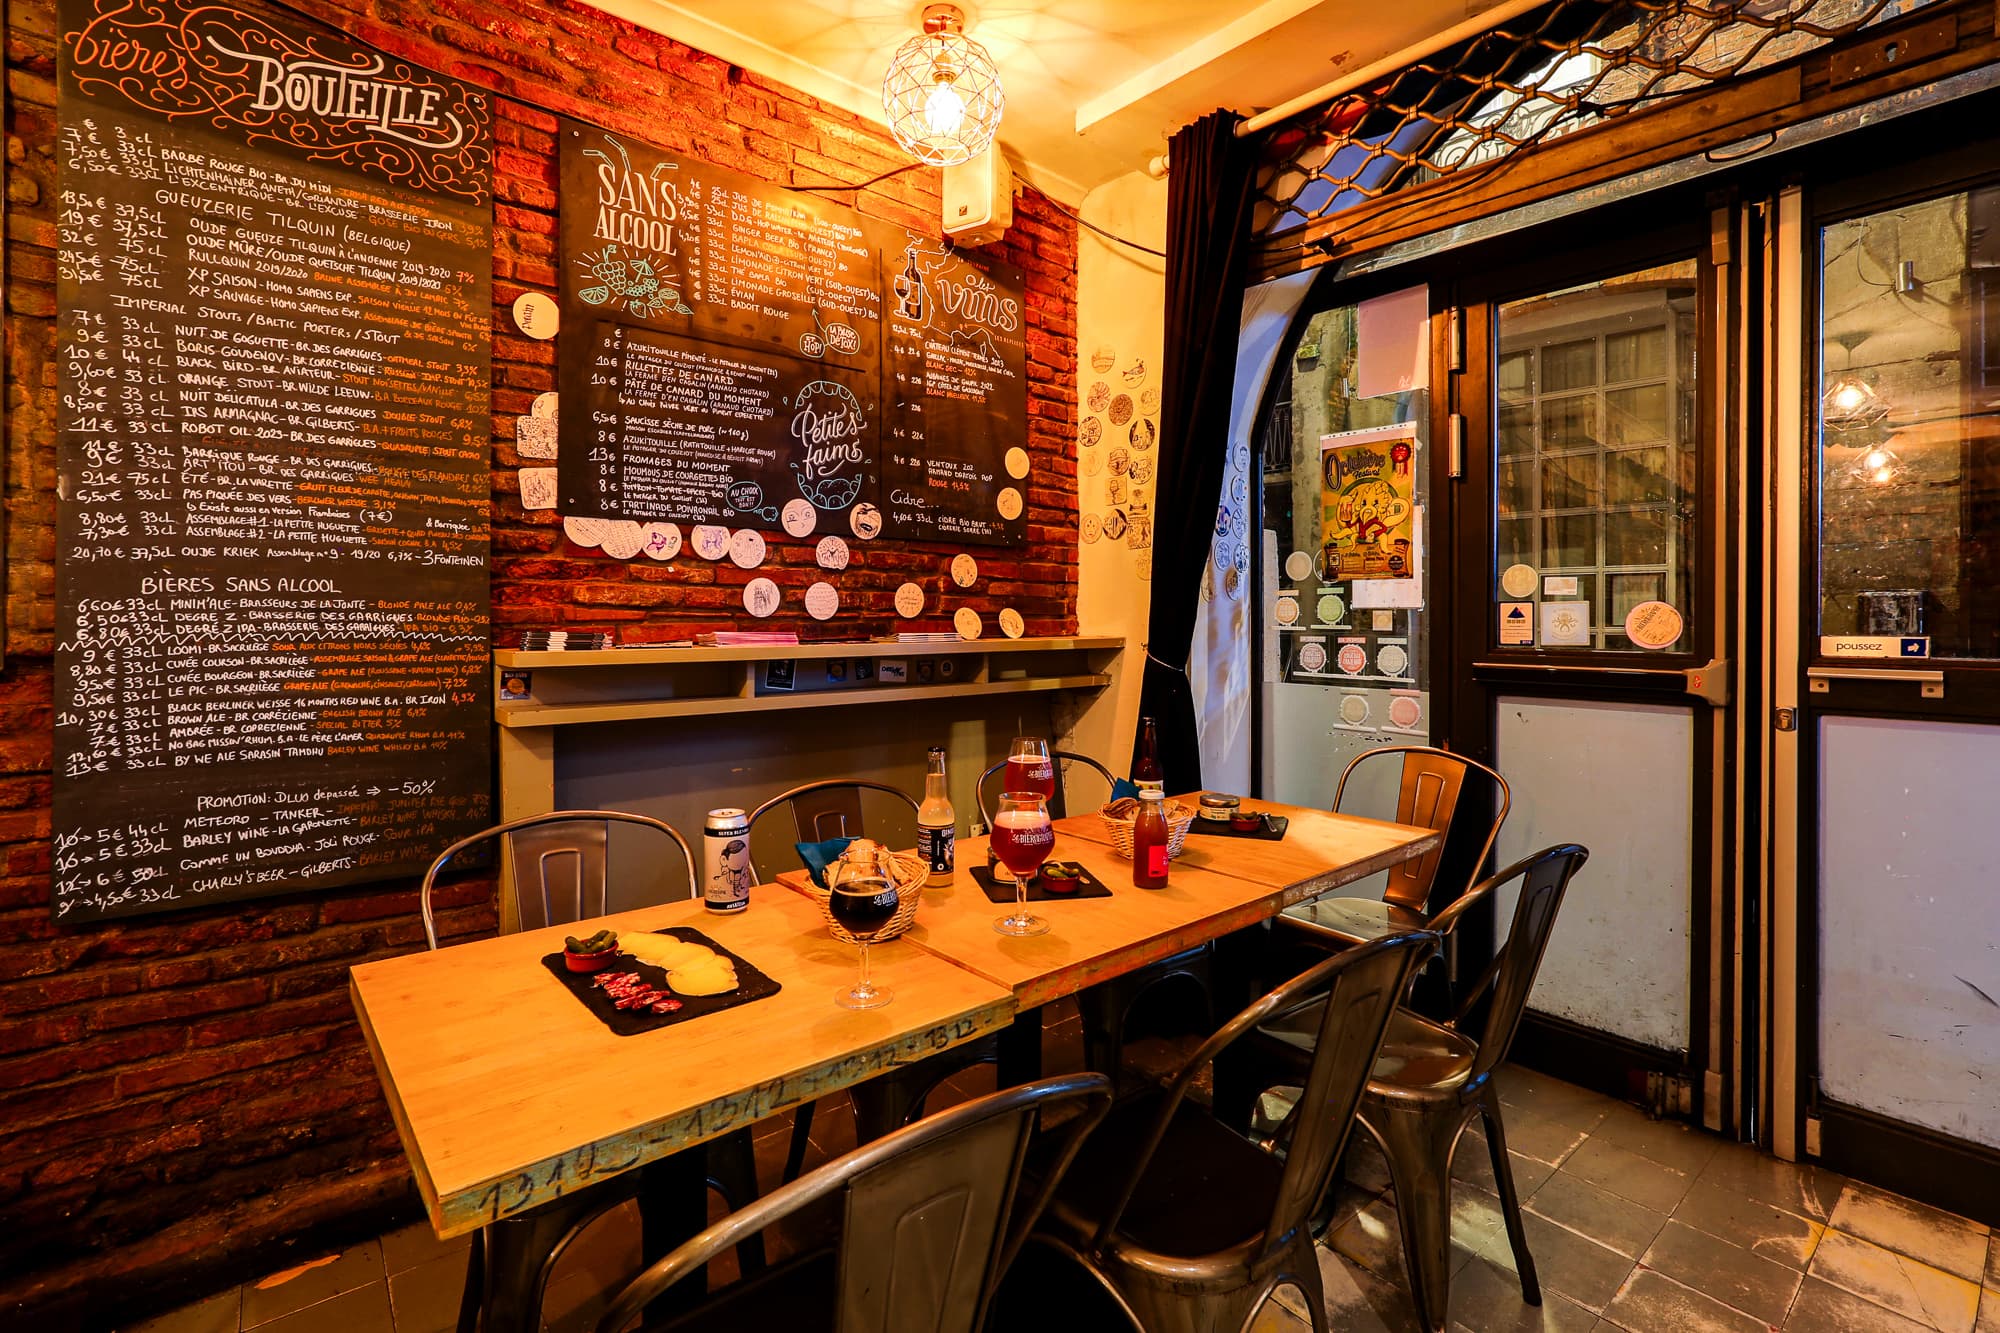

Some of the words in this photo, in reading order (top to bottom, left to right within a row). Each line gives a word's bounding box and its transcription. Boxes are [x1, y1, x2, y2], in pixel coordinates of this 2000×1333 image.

[66, 14, 188, 90] bières
[230, 50, 462, 144] BOUTEILLE
[162, 149, 205, 166] BARBE
[210, 158, 244, 174] ROUGE
[250, 168, 267, 180] BIO
[597, 163, 677, 221] SANS
[732, 192, 748, 202] JUS
[368, 205, 418, 223] BRASSERIE
[732, 202, 748, 212] JUS
[156, 190, 253, 220] GUEUZERIE
[265, 211, 335, 237] TILQUIN
[344, 225, 410, 254] (BELGIQUE)
[593, 204, 676, 256] ALCOOL
[733, 225, 761, 238] GINGER
[765, 233, 784, 245] BEER
[190, 218, 227, 235] OUDE
[236, 228, 283, 245] GUEUZE
[289, 238, 335, 257] TILQUIN
[402, 261, 450, 278] 2019-2020
[456, 272, 474, 283] 7%
[186, 235, 224, 250] OUDE
[308, 255, 355, 274] QUETSCHE
[358, 265, 395, 282] TILQUIN
[399, 272, 441, 290] 2019/2020
[188, 249, 249, 269] RULLQUIN
[255, 261, 308, 279] 2019/2020
[187, 267, 209, 282] XP
[211, 273, 256, 288] SAISON
[806, 274, 824, 285] VERT
[188, 284, 209, 297] XP
[213, 289, 264, 305] SAUVAGE
[731, 287, 755, 300] ÉVIAN
[110, 294, 187, 314] IMPERIAL
[731, 301, 760, 312] BADOIT
[764, 307, 789, 319] ROUGE
[175, 325, 207, 337] NUIT
[210, 330, 228, 341] DE
[232, 332, 289, 350] GOGUETTE
[332, 346, 382, 362] GARRIGUES
[177, 340, 215, 356] BORIS
[176, 355, 216, 369] BLACK
[625, 361, 674, 375] RILLETTES
[679, 369, 690, 380] DE
[694, 372, 734, 385] CANARD
[178, 374, 228, 388] ORANGE
[237, 378, 276, 390] STOUT
[335, 386, 371, 400] LEEUW
[625, 377, 646, 390] PÂTÉ
[666, 386, 703, 398] CANARD
[708, 391, 721, 401] DU
[724, 394, 761, 406] MOMENT
[181, 406, 207, 417] IRS
[214, 406, 279, 424] ARMAGNAC
[301, 403, 321, 412] DES
[325, 404, 376, 419] GARRIGUES
[182, 422, 224, 434] ROBOT
[229, 426, 251, 436] OIL
[306, 432, 326, 443] DES
[686, 423, 696, 431] DE
[791, 403, 867, 447] Petites
[624, 454, 672, 467] FROMAGES
[677, 460, 688, 468] DU
[692, 462, 730, 472] MOMENT
[803, 439, 862, 480] faims
[927, 460, 957, 469] VENTOUX
[181, 468, 209, 484] ÉTÉ
[662, 470, 674, 478] DE
[676, 470, 718, 482] COURGETTES
[183, 490, 202, 499] PAS
[246, 493, 265, 503] DES
[269, 494, 292, 504] VERS
[199, 503, 230, 513] Existe
[233, 505, 256, 513] aussi
[272, 507, 302, 515] version
[622, 501, 672, 512] TARTINADE
[317, 522, 360, 533] HUGUETTE
[322, 535, 368, 545] HUGUETTE
[182, 547, 216, 557] OUDE
[224, 547, 260, 557] KRIEK
[351, 551, 380, 560] 19/20
[141, 568, 215, 595] BIÈRES
[226, 577, 271, 592] SANS
[278, 578, 342, 593] ALCOOL
[240, 600, 297, 610] BRASSEURS
[333, 600, 366, 609] JONTE
[238, 625, 256, 633] IPA
[168, 645, 201, 655] LOOMI
[1836, 642, 1882, 656] poussez
[166, 657, 198, 669] CUVÉE
[168, 669, 201, 683] CUVÉE
[205, 672, 253, 681] BOURGEON
[169, 687, 185, 697] LE
[189, 686, 208, 696] PIC
[168, 702, 201, 713] BLACK
[206, 701, 254, 710] BERLINER
[168, 716, 201, 724] BROWN
[206, 714, 225, 722] ALE
[169, 725, 214, 738] AMBRÉE
[175, 755, 189, 767] BY
[195, 754, 212, 764] WE
[217, 752, 235, 762] ALE
[240, 750, 280, 760] SARASIN
[274, 808, 324, 821] TANKER
[183, 831, 231, 848] BARLEY
[236, 850, 250, 861] UN
[256, 842, 305, 858] BOUDDHA
[343, 832, 372, 846] ROUGE
[256, 868, 287, 882] BEER
